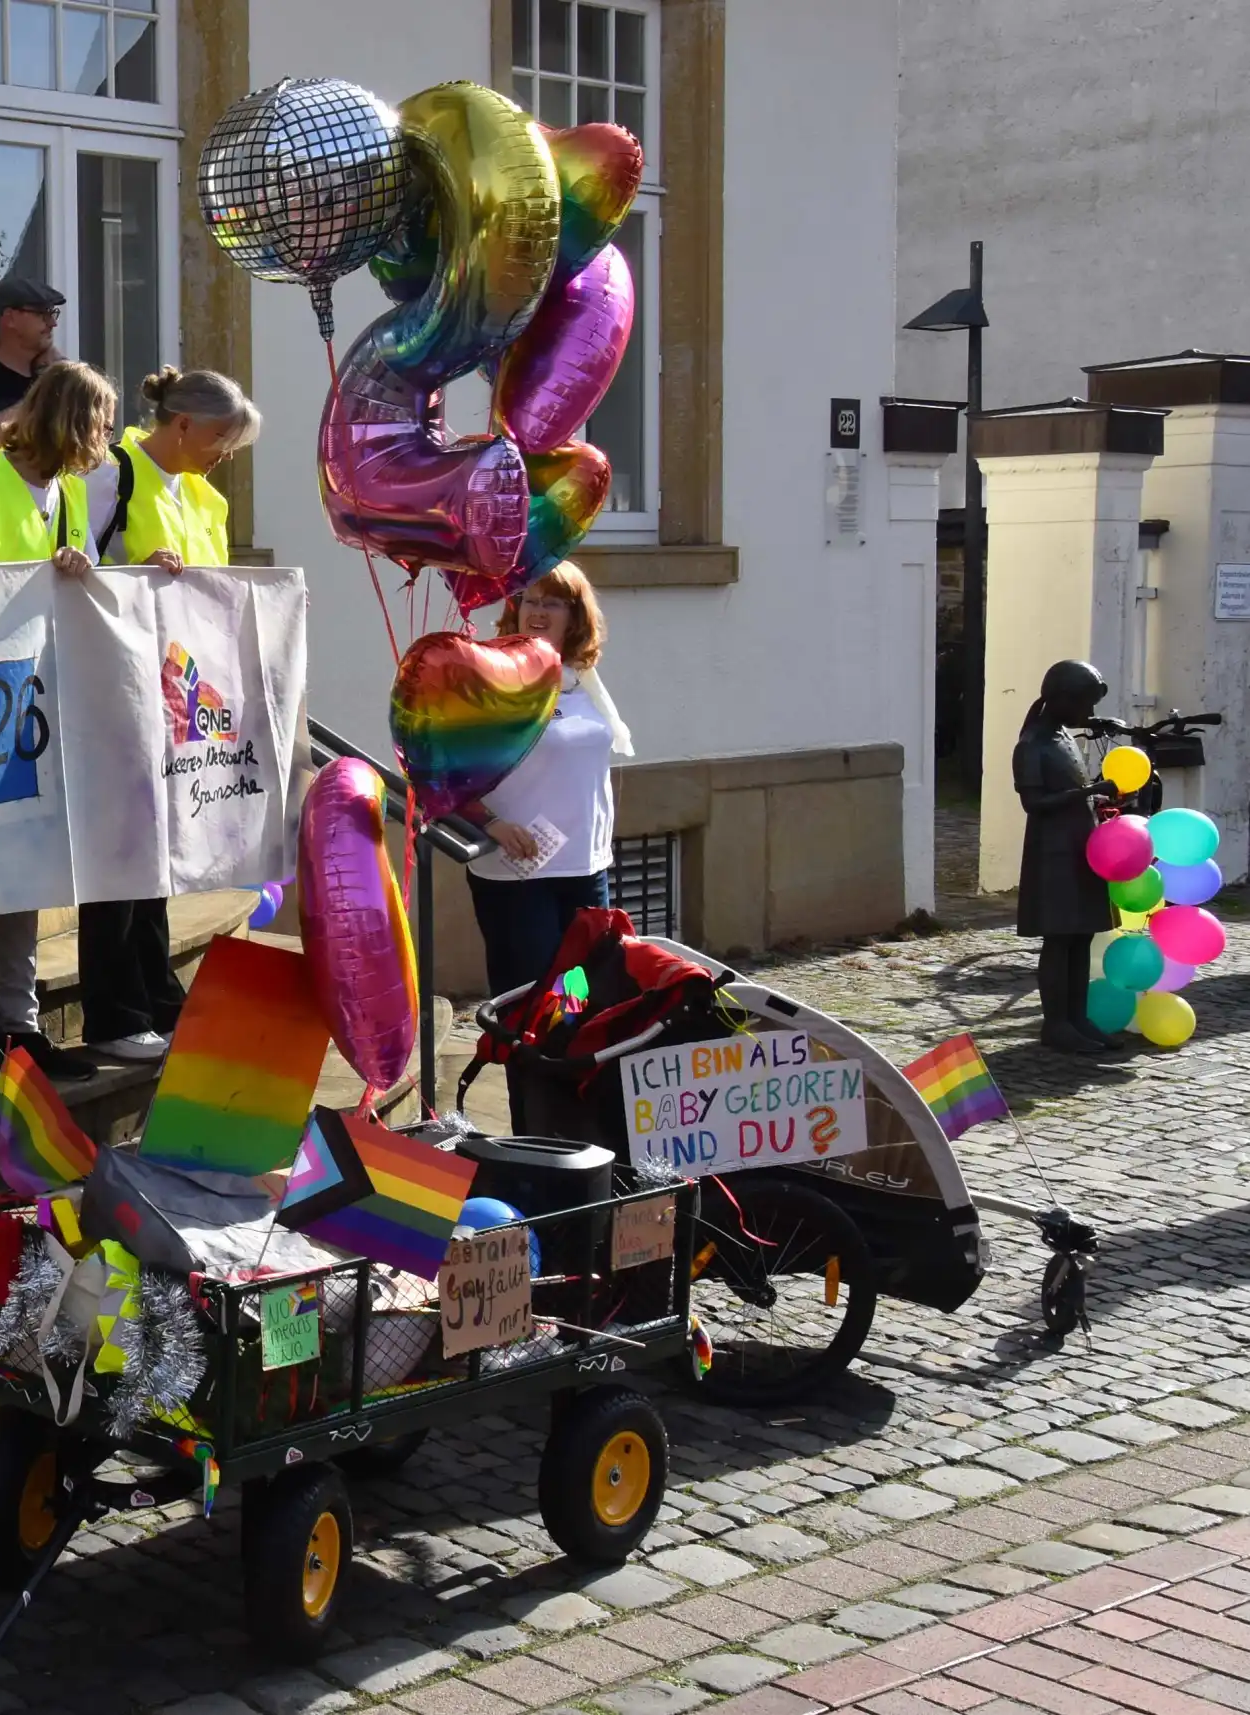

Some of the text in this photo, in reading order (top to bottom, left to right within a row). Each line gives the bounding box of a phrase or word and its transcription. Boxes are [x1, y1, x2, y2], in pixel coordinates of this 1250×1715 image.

[840, 413, 855, 433] 22
[196, 707, 232, 735] QNB
[190, 774, 264, 818] Bramsche
[630, 1035, 807, 1096] ICH BIN ALS
[634, 1088, 718, 1135] BABY
[647, 1130, 717, 1168] UND
[803, 1159, 912, 1189] URLEY
[269, 1299, 290, 1329] NO
[270, 1315, 312, 1346] means
[281, 1340, 303, 1363] NO
